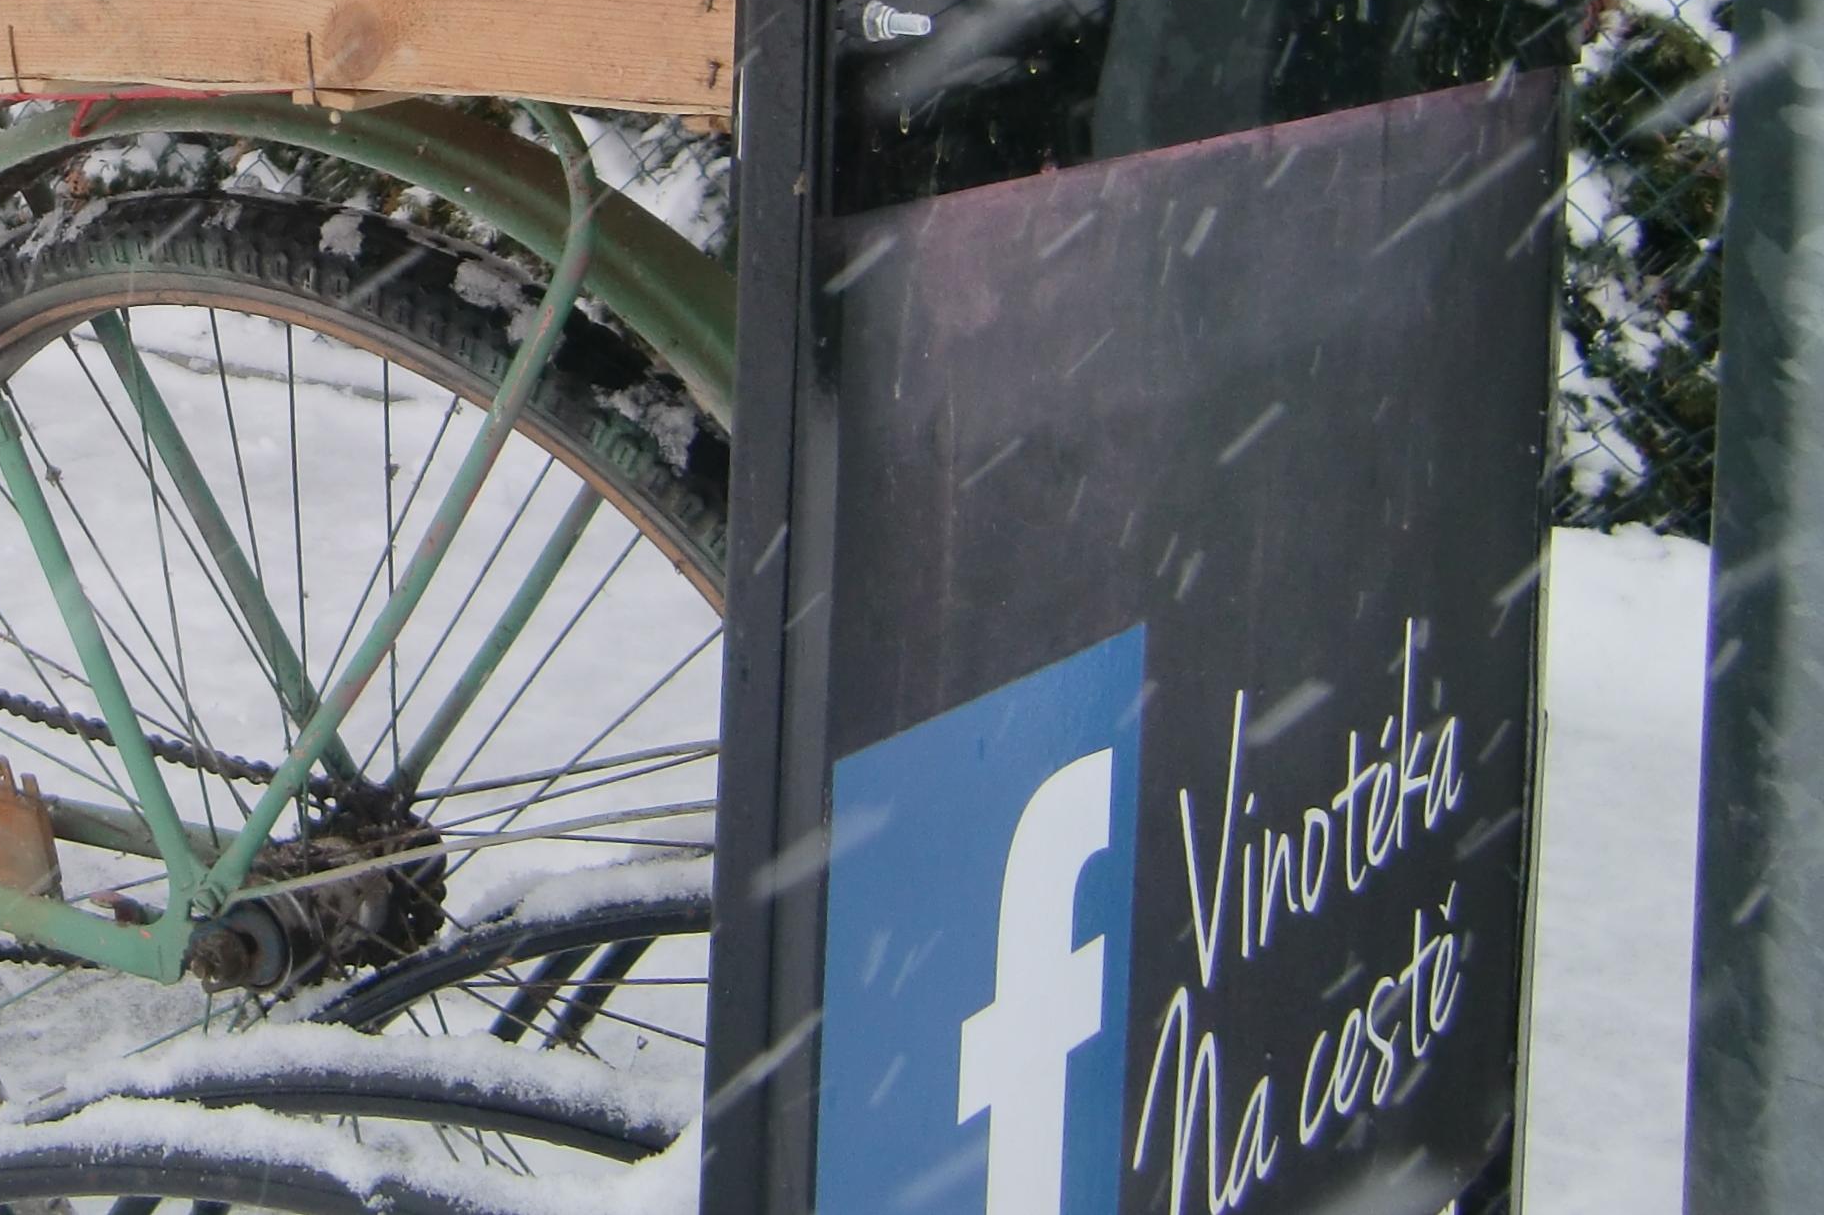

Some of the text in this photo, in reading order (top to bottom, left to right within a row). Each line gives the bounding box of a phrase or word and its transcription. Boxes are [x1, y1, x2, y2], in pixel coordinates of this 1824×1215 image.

[1179, 616, 1464, 989] Vinotéka
[1132, 881, 1464, 1215] Na cestě
